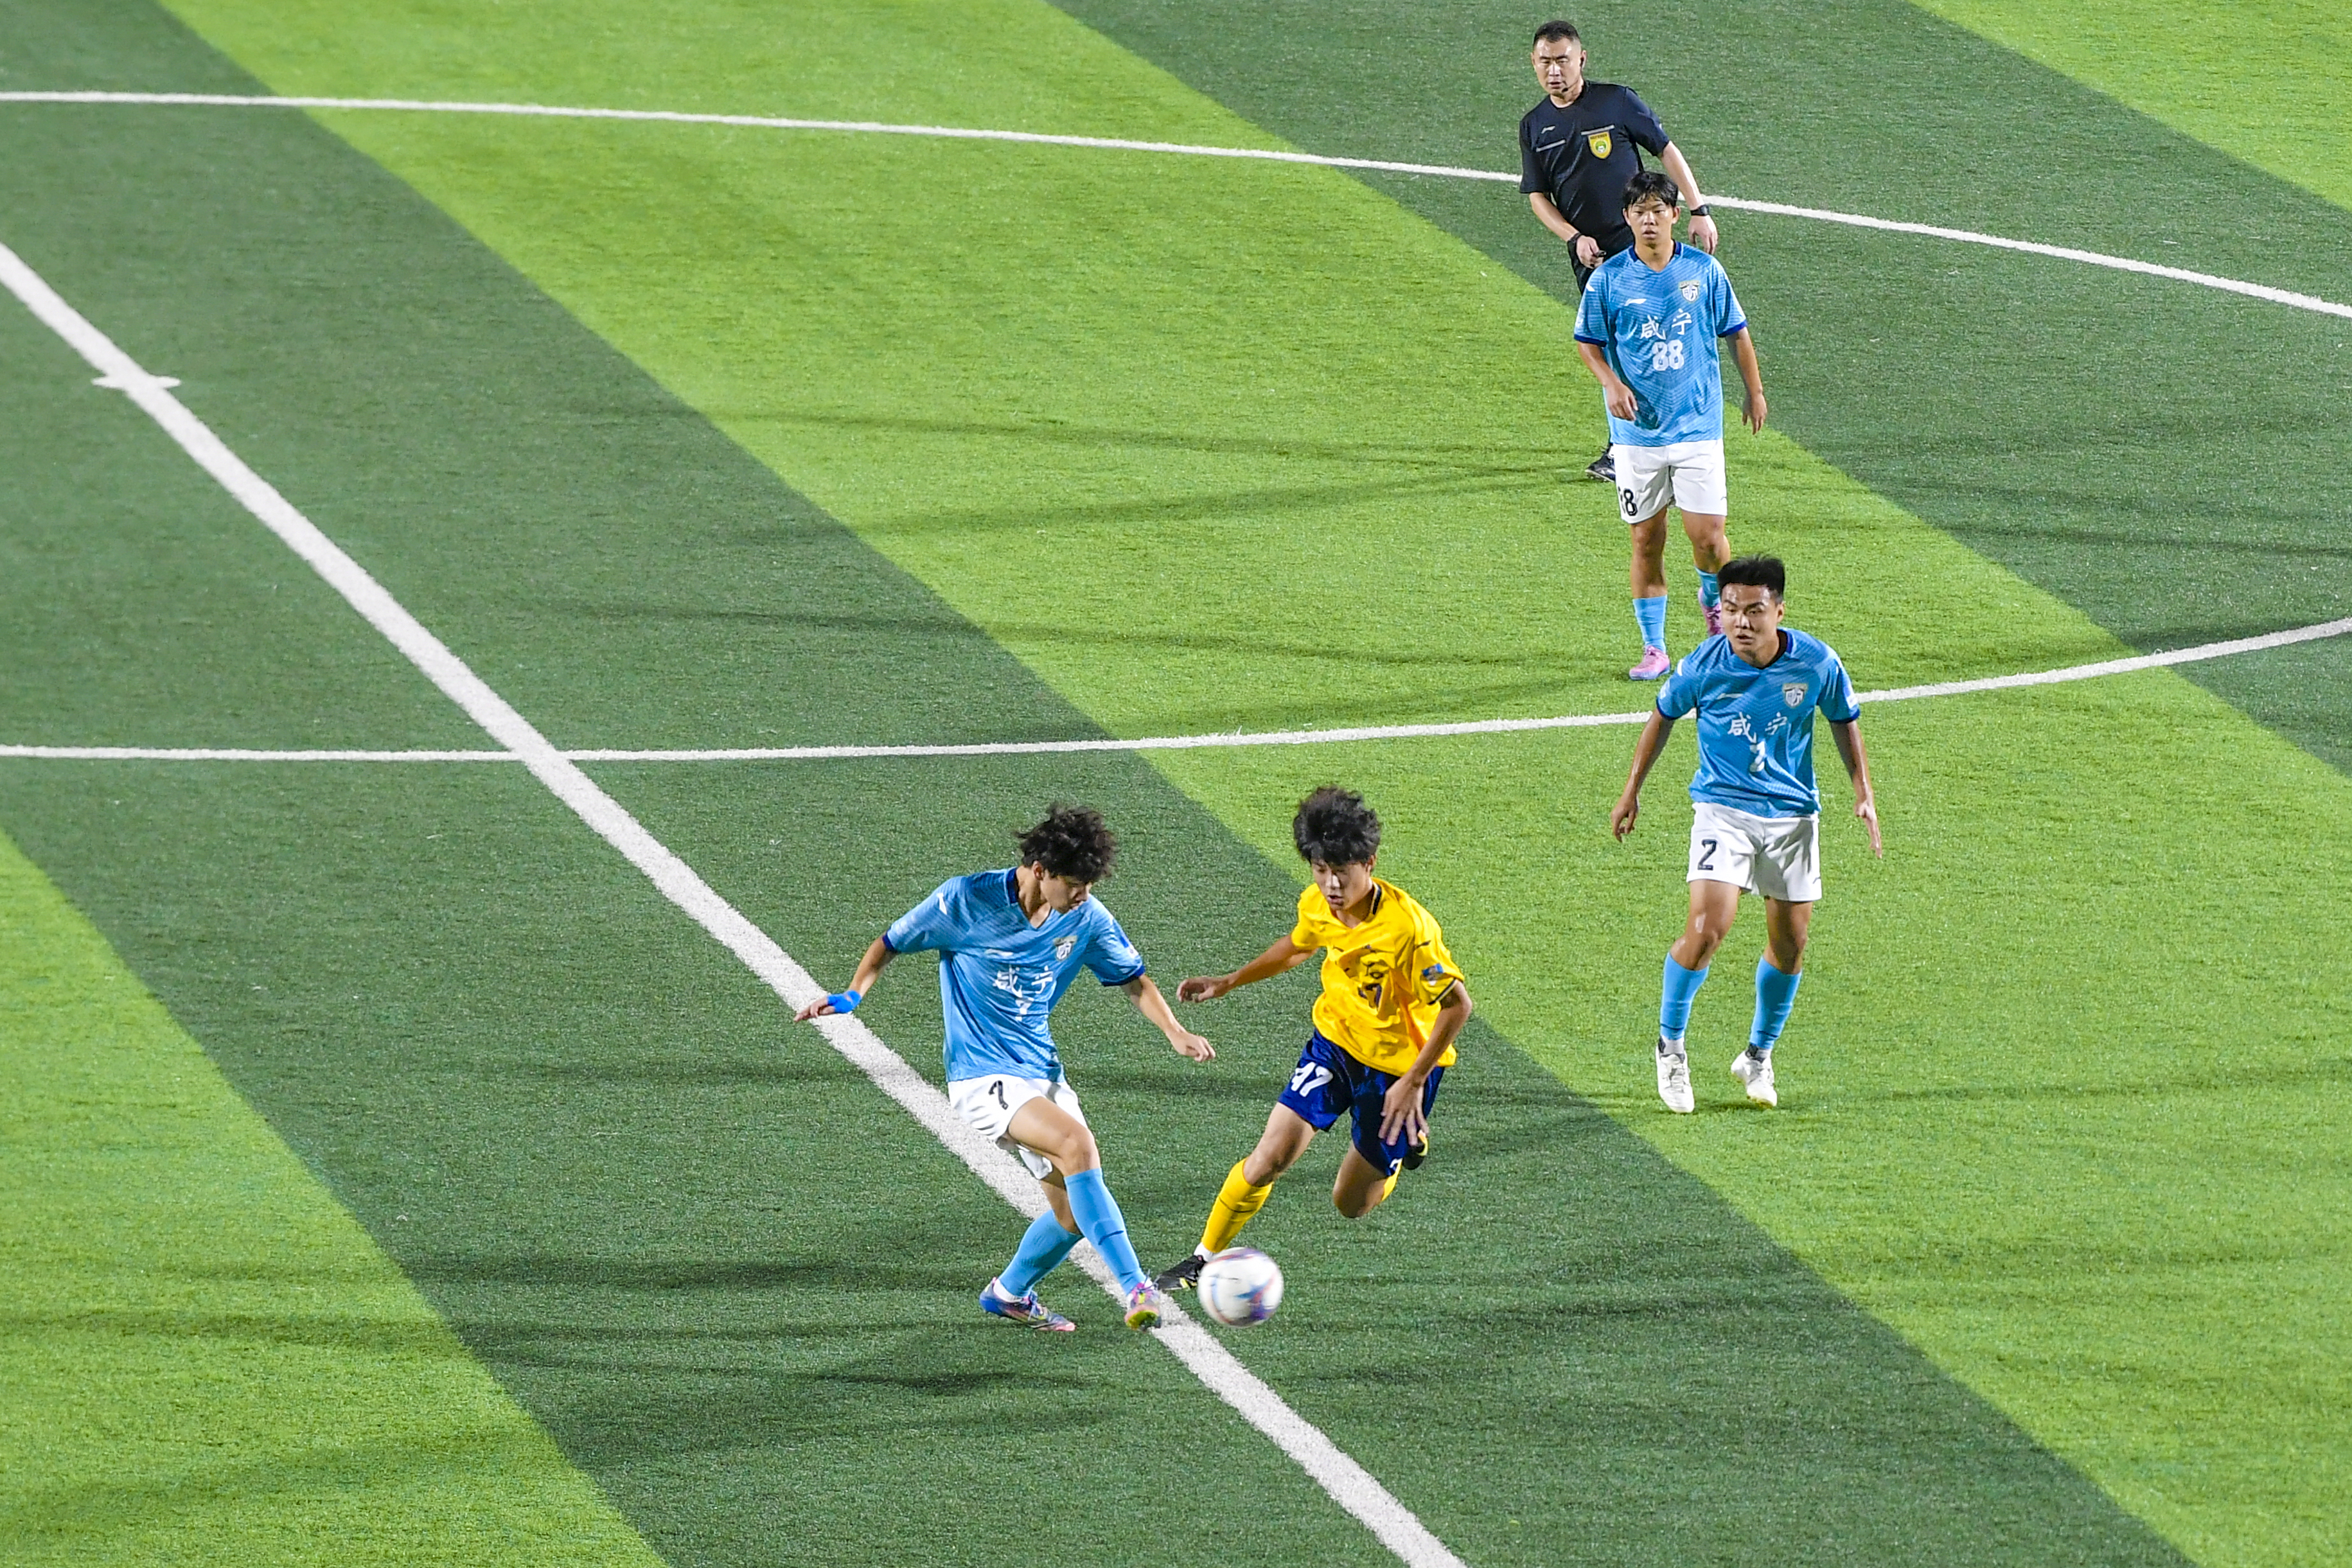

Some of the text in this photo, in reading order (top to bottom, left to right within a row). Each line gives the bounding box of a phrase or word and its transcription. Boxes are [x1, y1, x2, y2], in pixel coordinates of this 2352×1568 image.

[1640, 308, 1692, 340] 咸宁
[1652, 339, 1684, 371] 88
[1727, 712, 1788, 743] 咸宁
[1697, 839, 1717, 870] 2
[993, 964, 1054, 998] 咸宁
[988, 1080, 1009, 1110] 7
